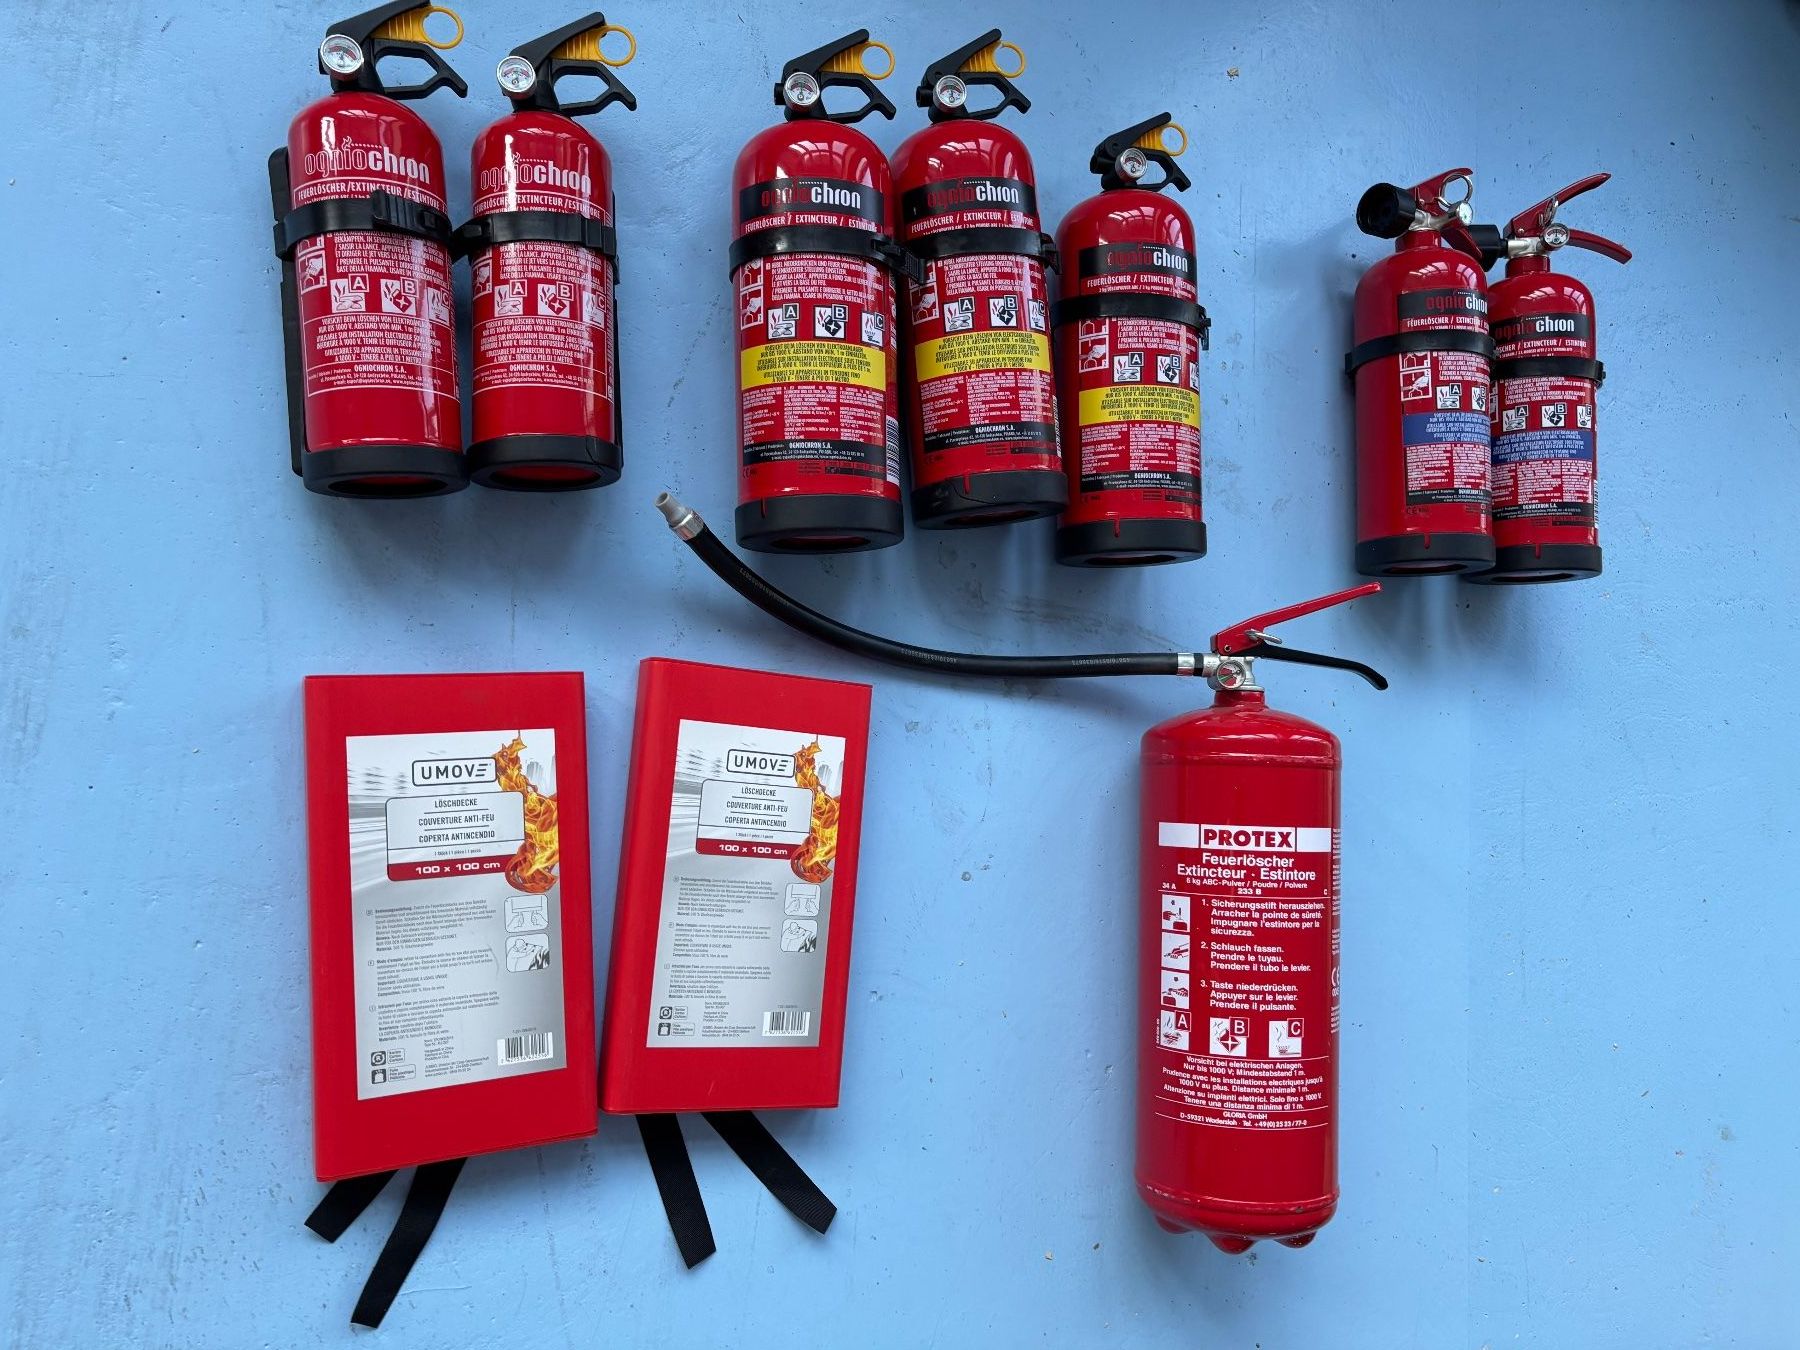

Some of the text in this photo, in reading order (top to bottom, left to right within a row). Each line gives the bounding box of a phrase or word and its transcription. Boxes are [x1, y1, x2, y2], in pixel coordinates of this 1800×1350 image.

[796, 214, 838, 224] EXTINCTEUR
[964, 212, 1002, 221] EXTINCTEUR
[1408, 317, 1448, 328] FEUERLÖSCHER
[734, 755, 788, 772] UMOVE
[421, 764, 488, 780] UMOVE
[742, 786, 776, 796] LÖSCHDECKE
[434, 798, 478, 808] LÖSCHDECKE
[726, 801, 788, 813] COUVERTURE ANTI-FEU
[418, 814, 494, 826] COUVERTURE ANTI-FEU
[725, 816, 786, 828] COPERTA ANTINCENDIO
[419, 830, 495, 842] COPERTA ANTINCENDIO
[1203, 828, 1293, 848] PROTEX
[1202, 852, 1294, 867] Feuerlöscher
[416, 866, 440, 874] 100
[456, 862, 480, 870] 100
[1177, 864, 1316, 881] Extincteur Estintore
[1203, 879, 1246, 887] ABC-Pulver
[1212, 899, 1276, 910] Sicherungsstift
[1279, 902, 1325, 910] herausziehen.
[1211, 908, 1249, 918] Arracher
[1262, 912, 1288, 921] pointe
[1211, 918, 1258, 928] Impugnare
[1261, 920, 1300, 928] l'estintore
[1211, 928, 1254, 936] sicurezza.
[1211, 942, 1251, 952] Schlauch
[1254, 944, 1284, 952] fassen.
[1211, 952, 1245, 960] Prendre
[1258, 955, 1284, 963] tuyau.
[1211, 961, 1250, 970] Prendere
[1210, 981, 1234, 990] Taste
[1236, 983, 1298, 992] niederdrücken.
[1210, 990, 1247, 1000] Appuyer
[1210, 1000, 1250, 1010] Prendere
[1260, 1003, 1296, 1012] pulsante.
[1178, 1014, 1301, 1035] A B C
[1187, 1056, 1214, 1065] Vorsicht
[1162, 1067, 1190, 1078] Prudence
[1223, 1078, 1267, 1086] installations
[1164, 1084, 1196, 1096] Attenzione
[1208, 1092, 1236, 1100] impianti
[1184, 1096, 1206, 1105] Tenere
